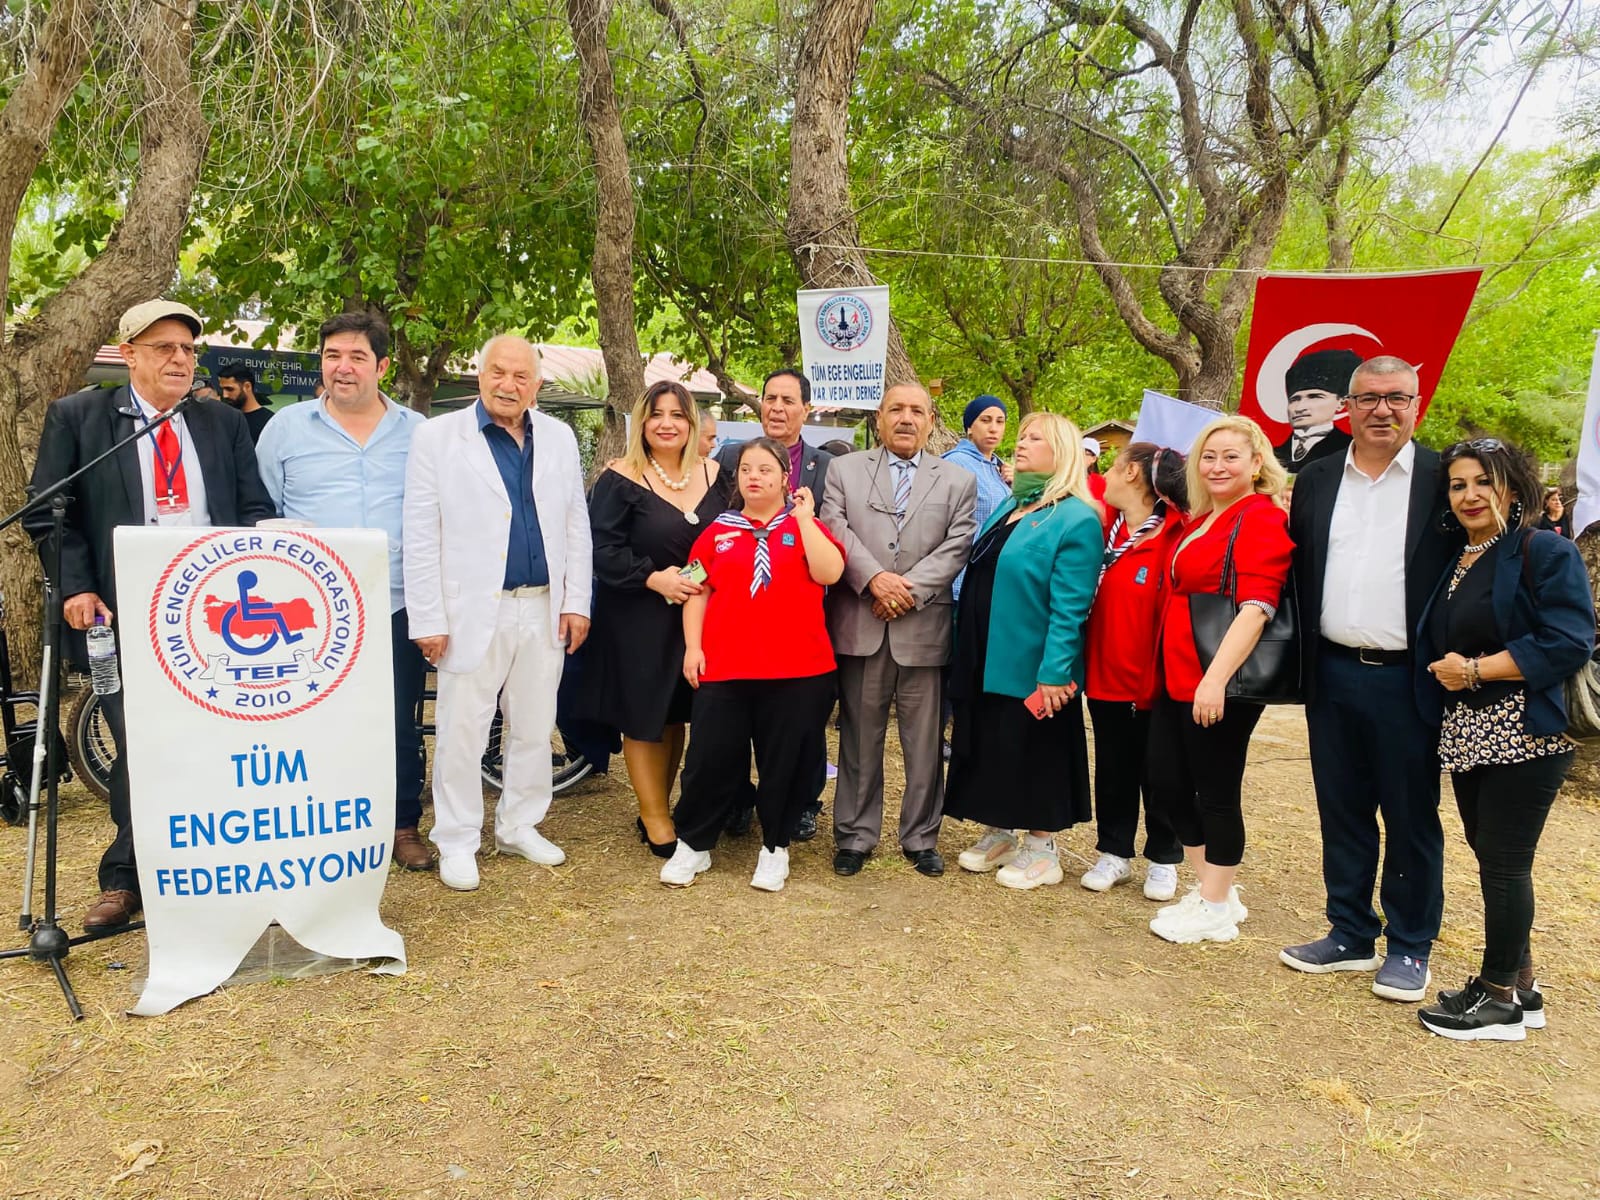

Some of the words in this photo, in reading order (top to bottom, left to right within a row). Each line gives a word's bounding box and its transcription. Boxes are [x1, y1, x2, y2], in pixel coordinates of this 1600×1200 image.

[811, 361, 827, 382] TÜM
[828, 363, 842, 381] EGE
[843, 359, 882, 381] ENGELLİLER
[812, 387, 827, 401] YAR.
[829, 386, 837, 401] VE
[838, 386, 854, 401] DAY.
[164, 535, 264, 625] ENGELLİLER
[272, 538, 351, 672] FEDERASYONU
[166, 628, 199, 680] TÜM
[226, 663, 300, 681] TEF
[235, 690, 292, 708] 2010
[231, 743, 308, 787] TÜM
[168, 796, 372, 849] ENGELLİLER
[157, 842, 385, 896] FEDERASYONU
